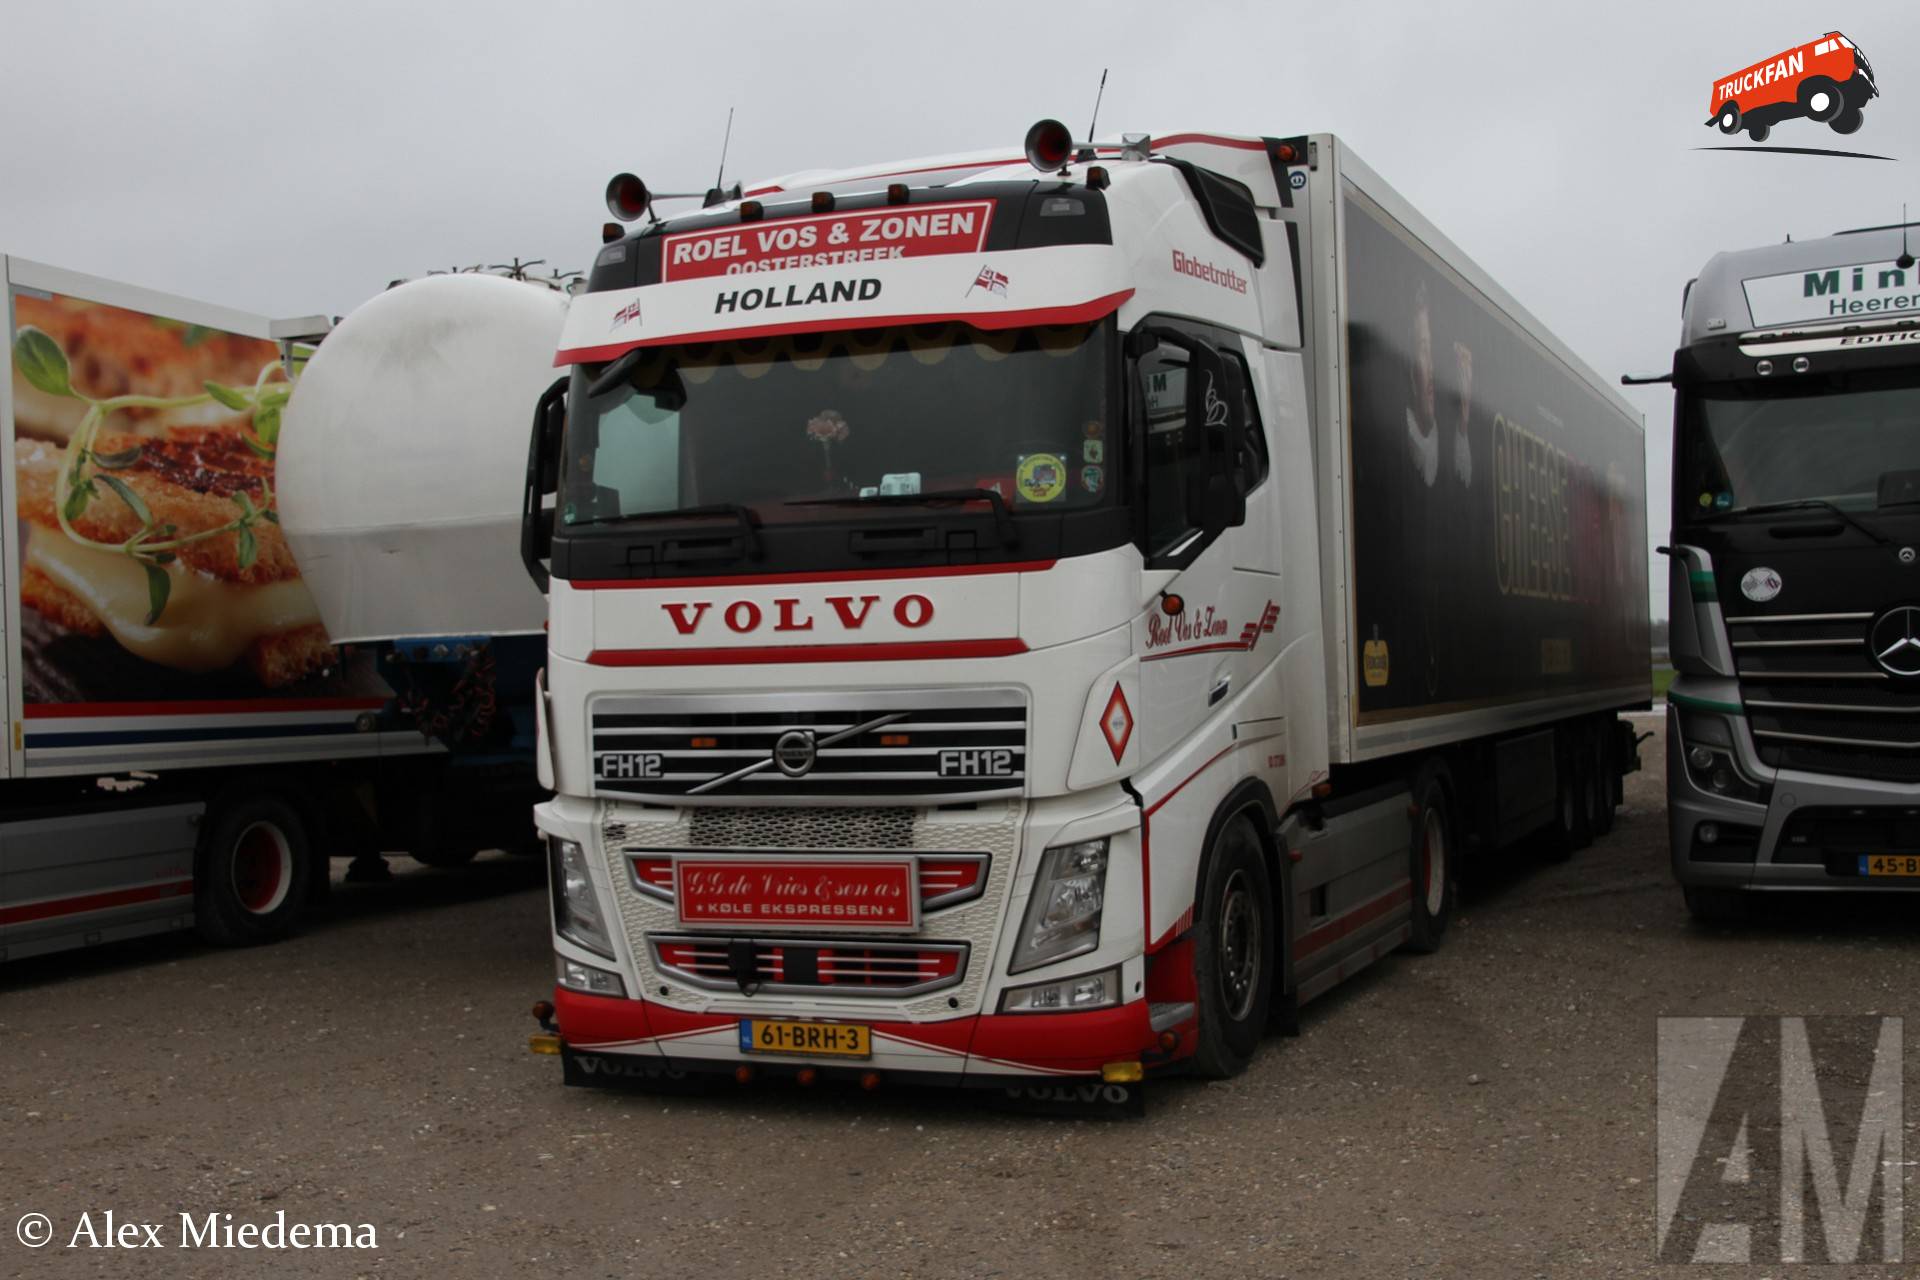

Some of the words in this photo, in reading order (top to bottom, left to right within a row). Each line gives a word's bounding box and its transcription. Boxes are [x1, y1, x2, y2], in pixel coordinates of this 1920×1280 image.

[673, 235, 748, 265] ROEL
[757, 225, 817, 253] VOS
[827, 222, 849, 245] &
[860, 211, 976, 242] ZONEN
[726, 245, 906, 276] OOSTERSTREEK
[1172, 249, 1247, 294] Globetrotter
[1804, 261, 1920, 298] Min
[714, 278, 882, 314] HOLLAND
[661, 594, 935, 635] VOLVO
[602, 754, 661, 777] FH12
[941, 751, 1012, 775] FH12
[762, 873, 807, 895] Vries
[708, 903, 752, 913] KØLE
[761, 903, 883, 915] EKSPRESSEN
[762, 1024, 859, 1050] 61-BRH-3
